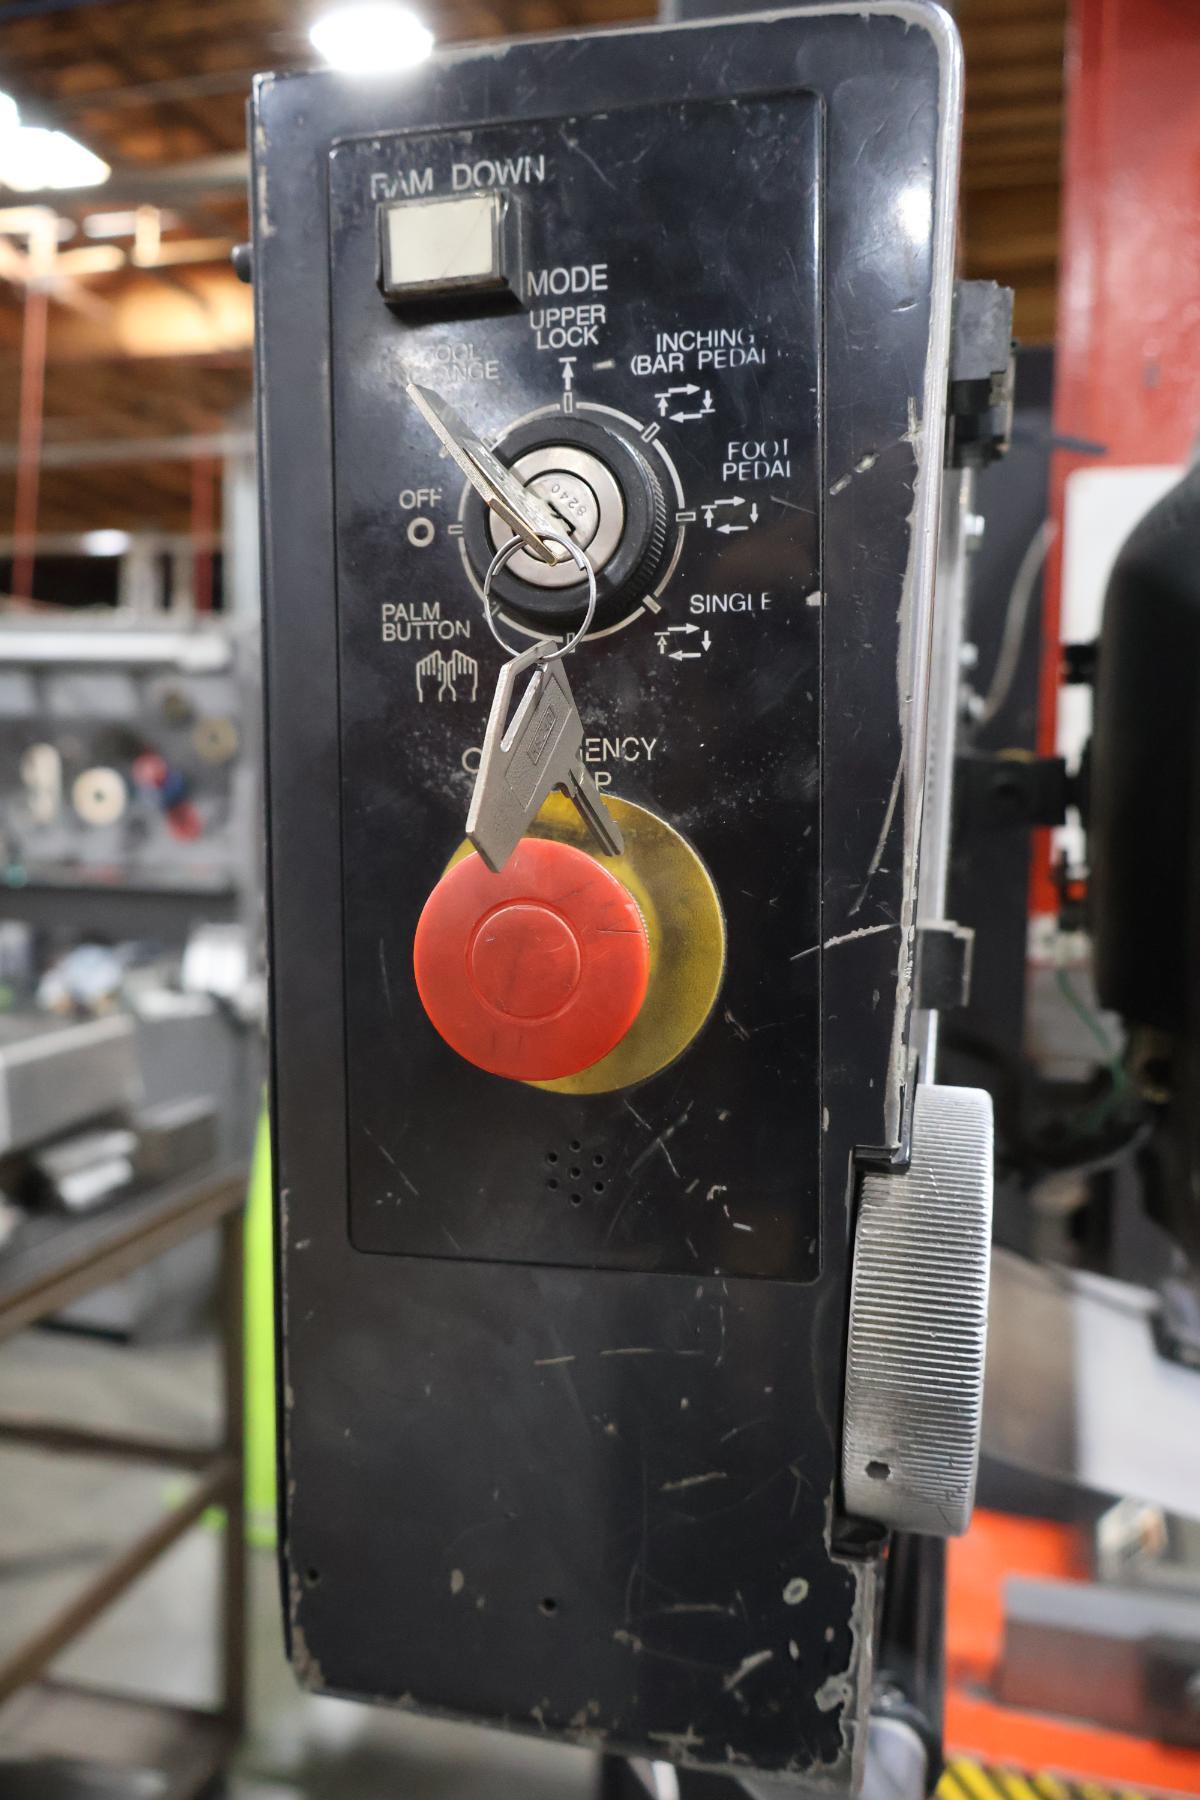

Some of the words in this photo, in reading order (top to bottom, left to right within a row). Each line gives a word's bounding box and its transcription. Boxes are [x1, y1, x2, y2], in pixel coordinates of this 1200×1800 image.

[452, 155, 545, 190] DOWN
[527, 264, 608, 296] MODE
[530, 304, 606, 330] UPPER
[537, 326, 599, 350] LOCK
[656, 328, 755, 353] INCHING
[630, 352, 685, 376] (BAR
[398, 487, 443, 510] OFF
[381, 602, 440, 622] PALM
[382, 621, 472, 642] BUTTON
